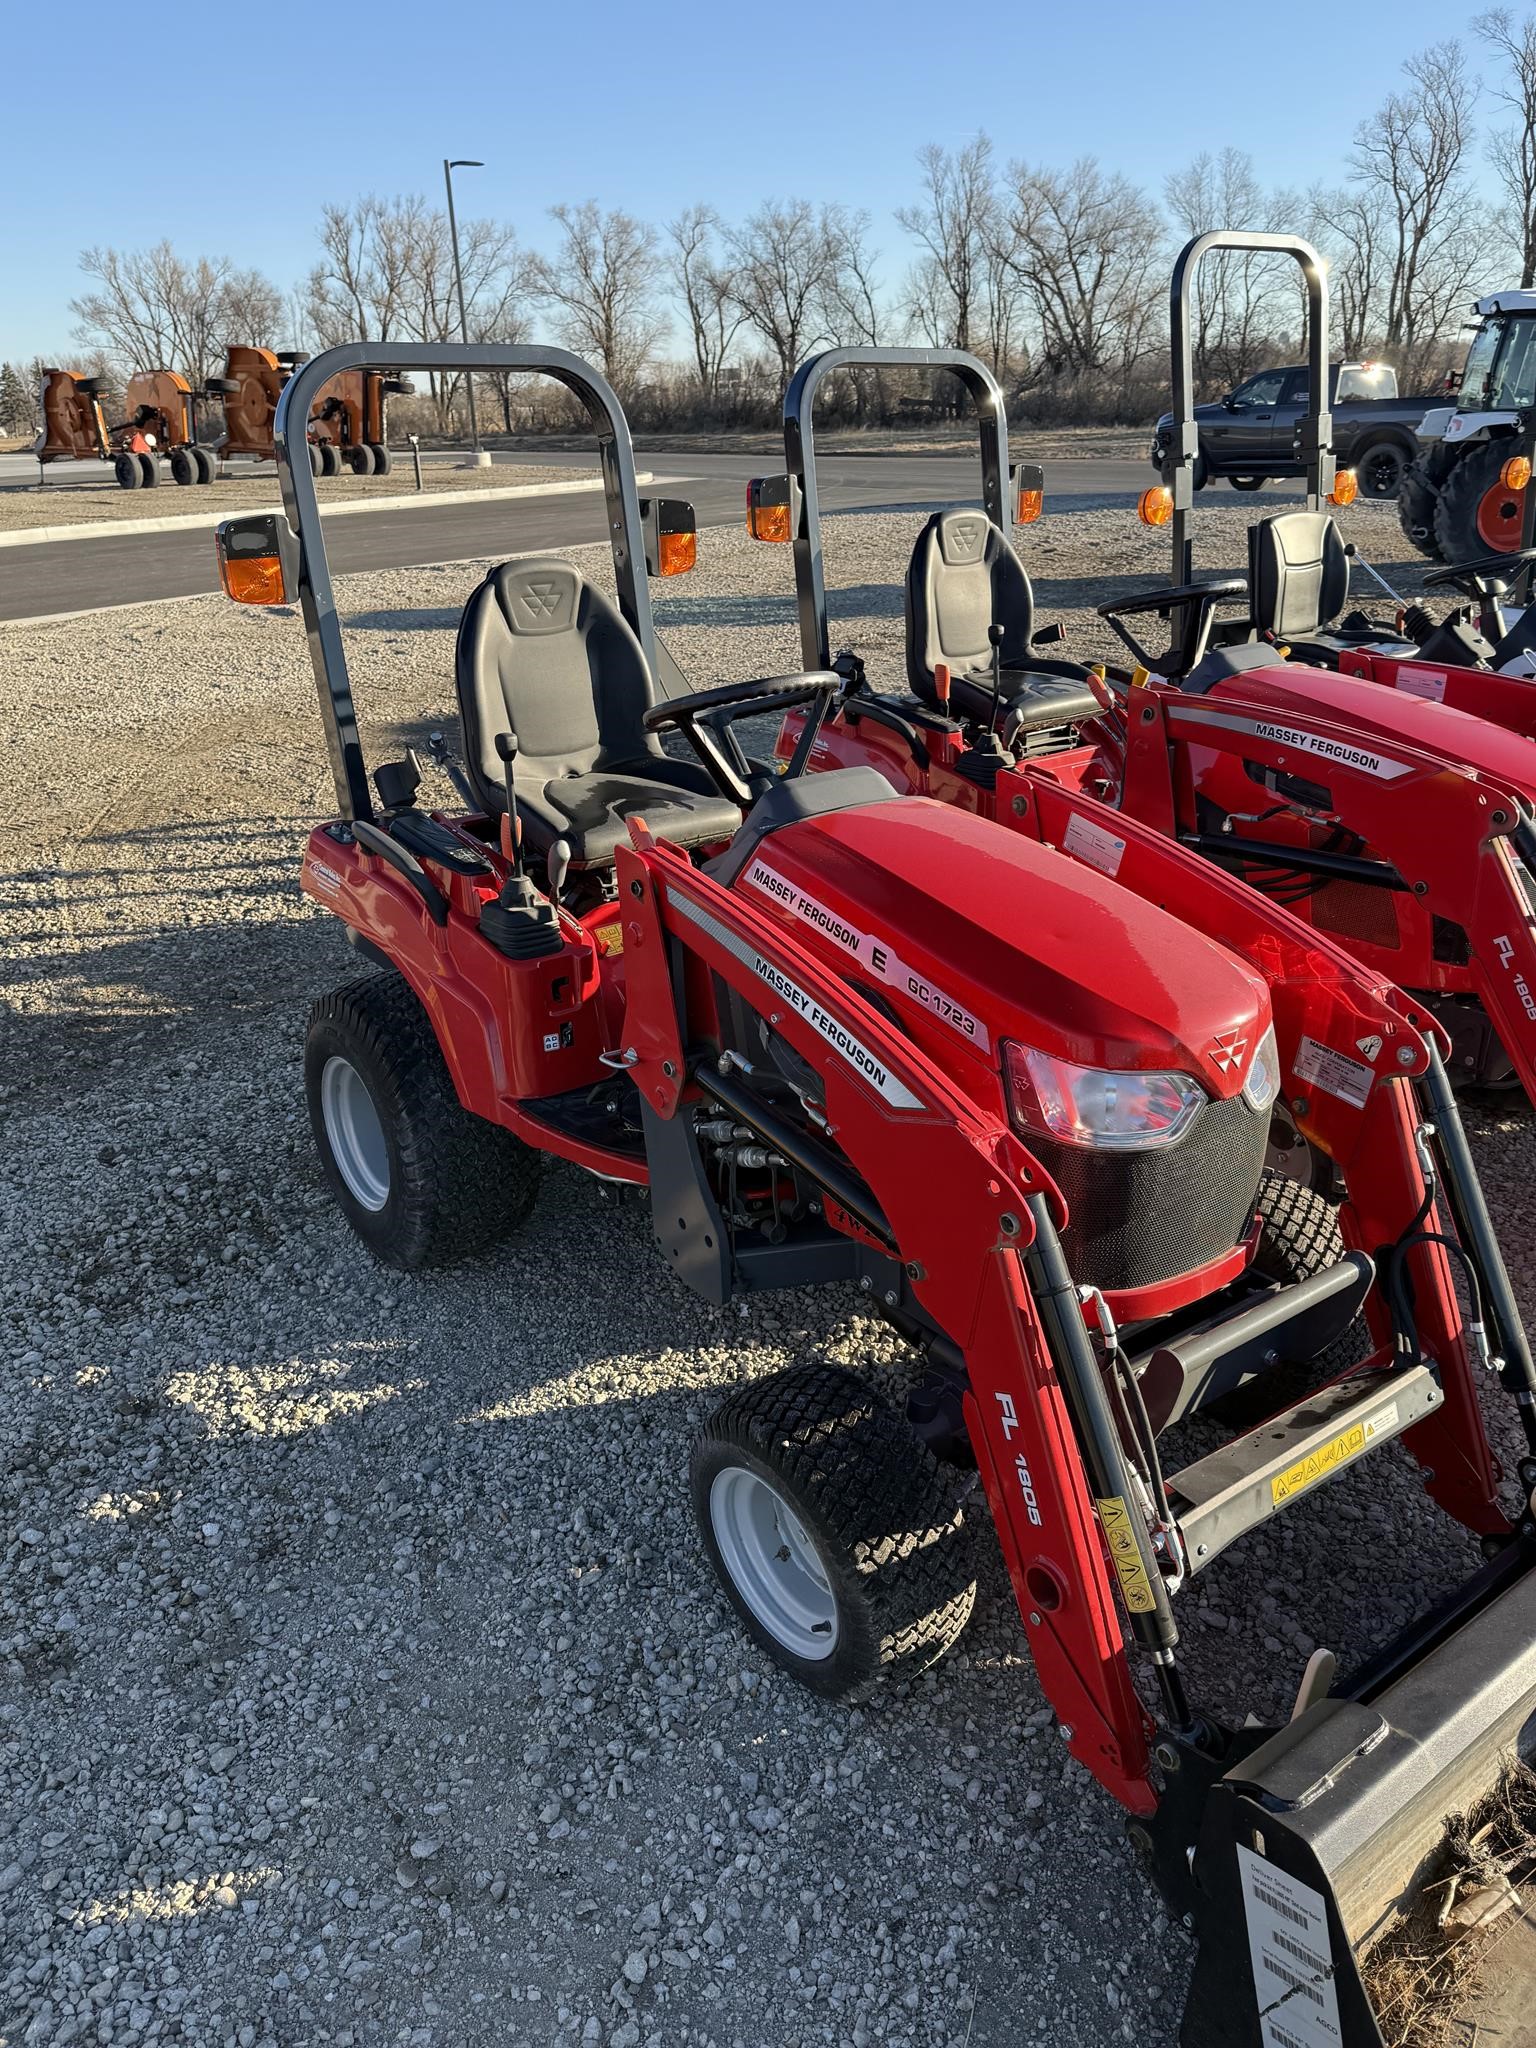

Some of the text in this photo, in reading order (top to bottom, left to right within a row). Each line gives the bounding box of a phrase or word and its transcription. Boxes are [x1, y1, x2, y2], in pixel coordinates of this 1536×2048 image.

[1256, 723, 1380, 771] MASSEY FERGUSON
[753, 867, 976, 1035] MASSEY FERGUSON E GC 1723
[1492, 935, 1516, 970] FL
[755, 957, 887, 1087] MASSEY FERGUSON
[1309, 1040, 1334, 1056] MASSEY
[1333, 1053, 1366, 1073] FERGUSON
[994, 1391, 1043, 1527] FL 1805
[1315, 2015, 1339, 2036] AGCO
